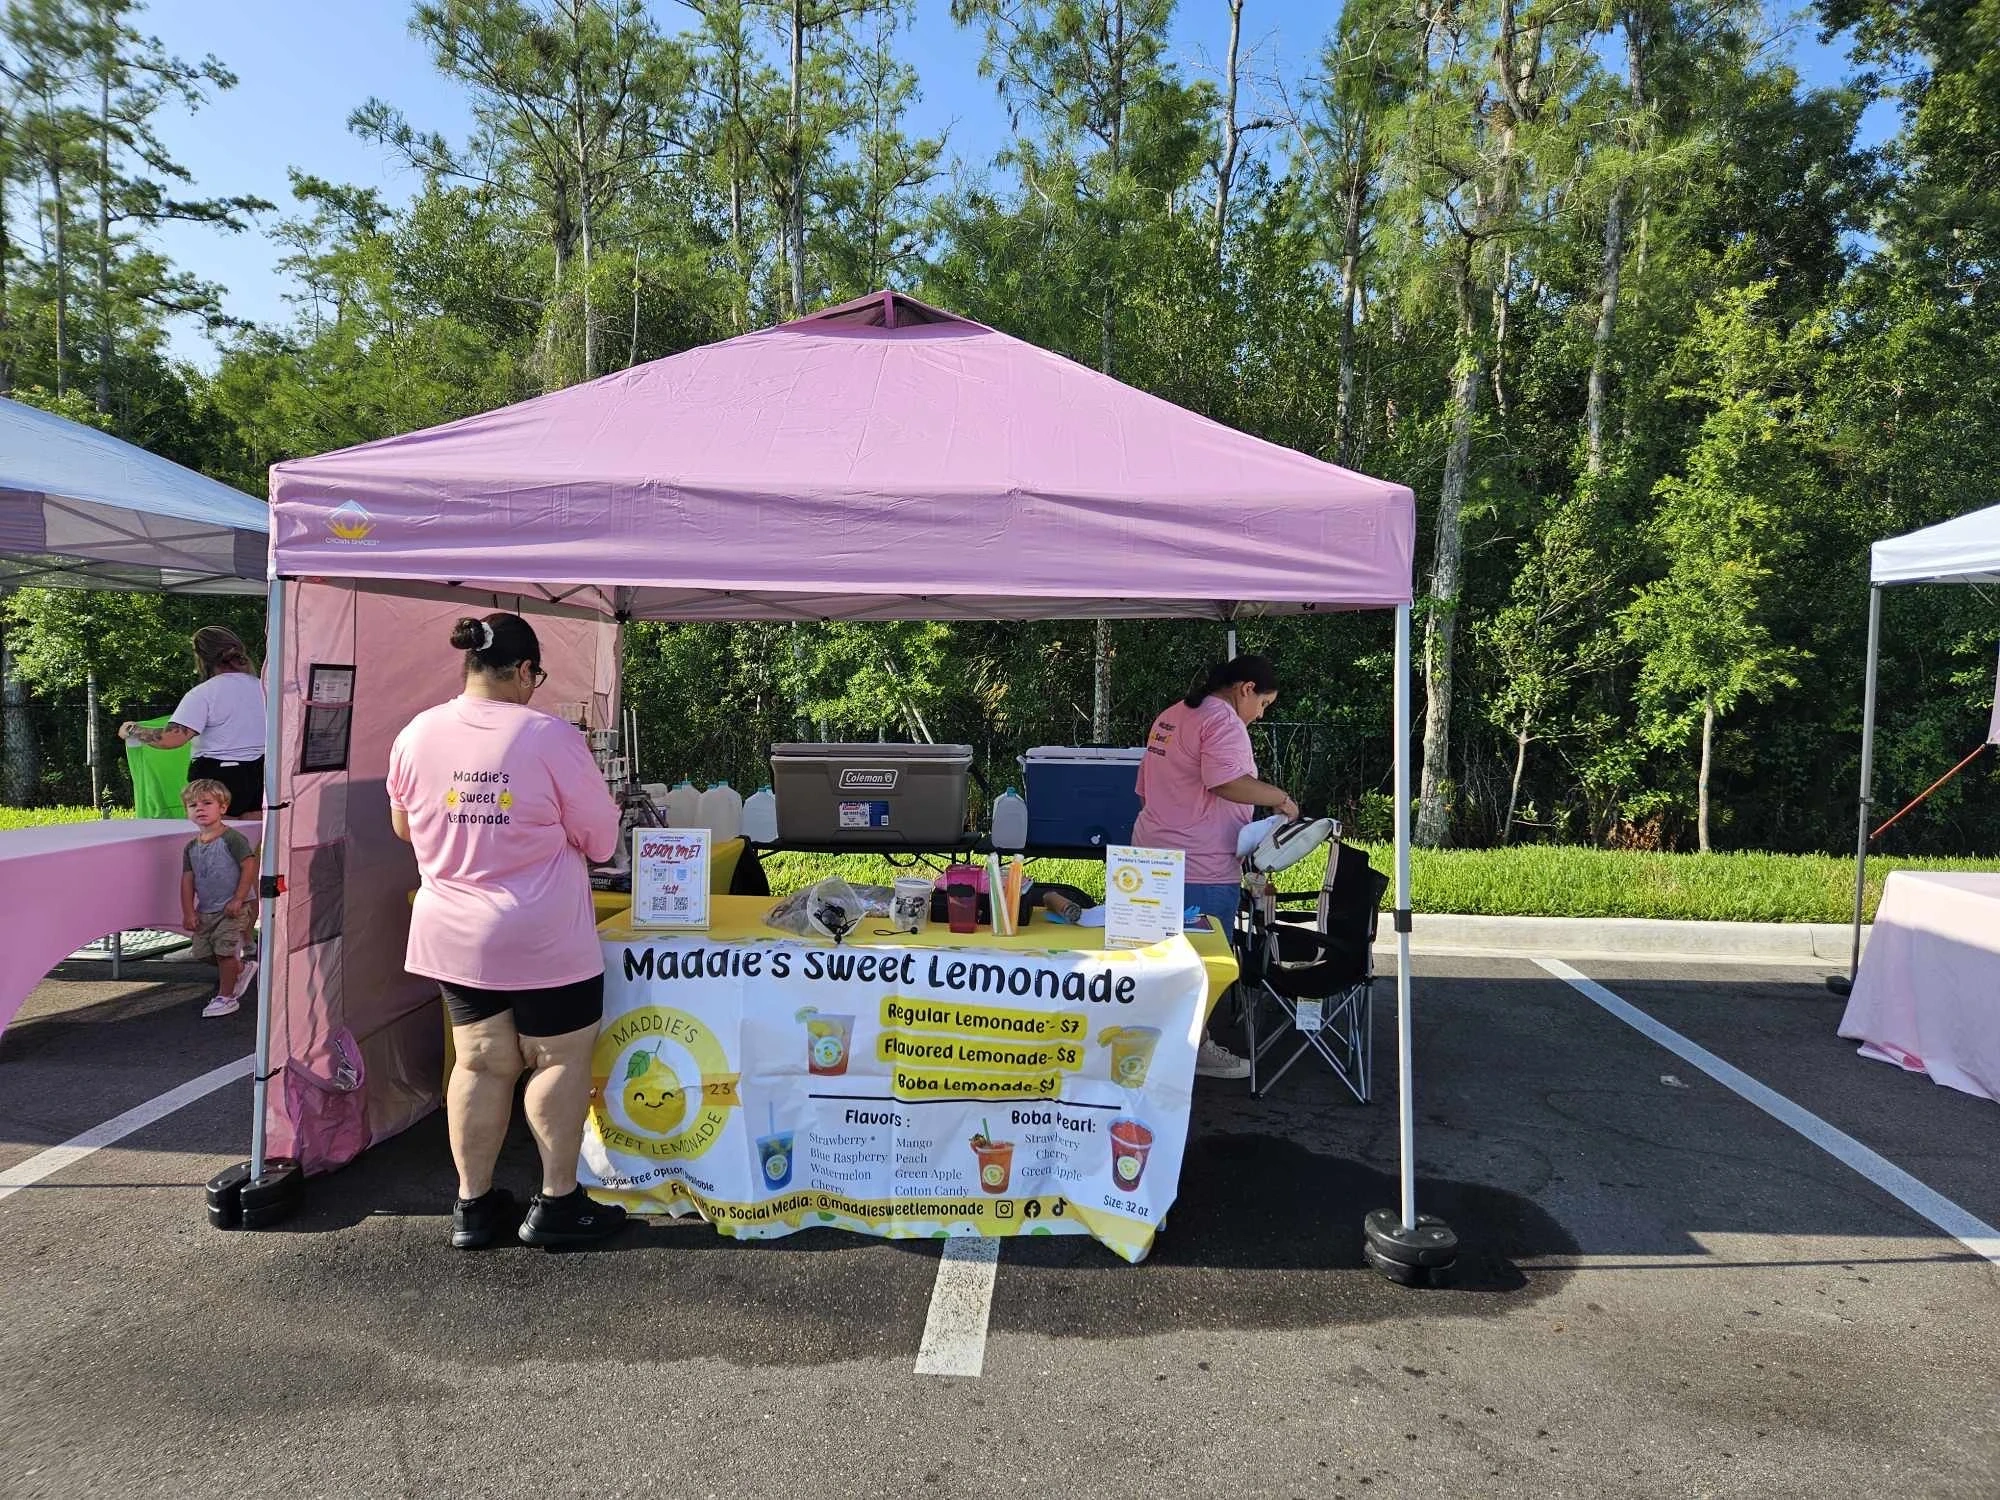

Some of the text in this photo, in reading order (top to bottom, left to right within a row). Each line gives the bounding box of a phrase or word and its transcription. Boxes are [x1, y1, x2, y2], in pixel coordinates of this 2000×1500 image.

[453, 770, 510, 783] Maddie's
[845, 772, 883, 783] Coleman
[459, 791, 496, 804] Sweet
[447, 812, 510, 824] Lemonade
[623, 947, 1136, 1004] Maddie's Sweet Lemonade
[887, 1003, 951, 1025] Regular
[1060, 1019, 1080, 1033] $7
[612, 1014, 698, 1047] MADDIE'S
[884, 1038, 953, 1059] Flavored
[1056, 1046, 1076, 1063] $8
[709, 1082, 731, 1096] 23
[897, 1073, 938, 1092] Boba
[845, 1109, 902, 1127] Flavors
[1011, 1110, 1051, 1125] Boba
[651, 1111, 723, 1155] LEMONADE
[808, 1132, 868, 1147] Strawberry
[1024, 1131, 1081, 1151] Strawberry
[895, 1137, 933, 1149] Mango
[810, 1147, 888, 1164] Blue Raspberry
[895, 1152, 928, 1164] Peach
[1036, 1148, 1068, 1163] Cherry
[810, 1162, 872, 1181] Watermelon
[895, 1168, 963, 1181] Green Apple
[1021, 1165, 1052, 1177] Green
[811, 1178, 845, 1195] Cherry
[894, 1184, 969, 1199] Cotton Candy
[710, 1205, 726, 1218] on
[729, 1205, 770, 1219] Social
[772, 1195, 813, 1215] Media:
[816, 1194, 984, 1217] @maddiesweetlemonade
[1103, 1194, 1149, 1217] Size: 32 oz
